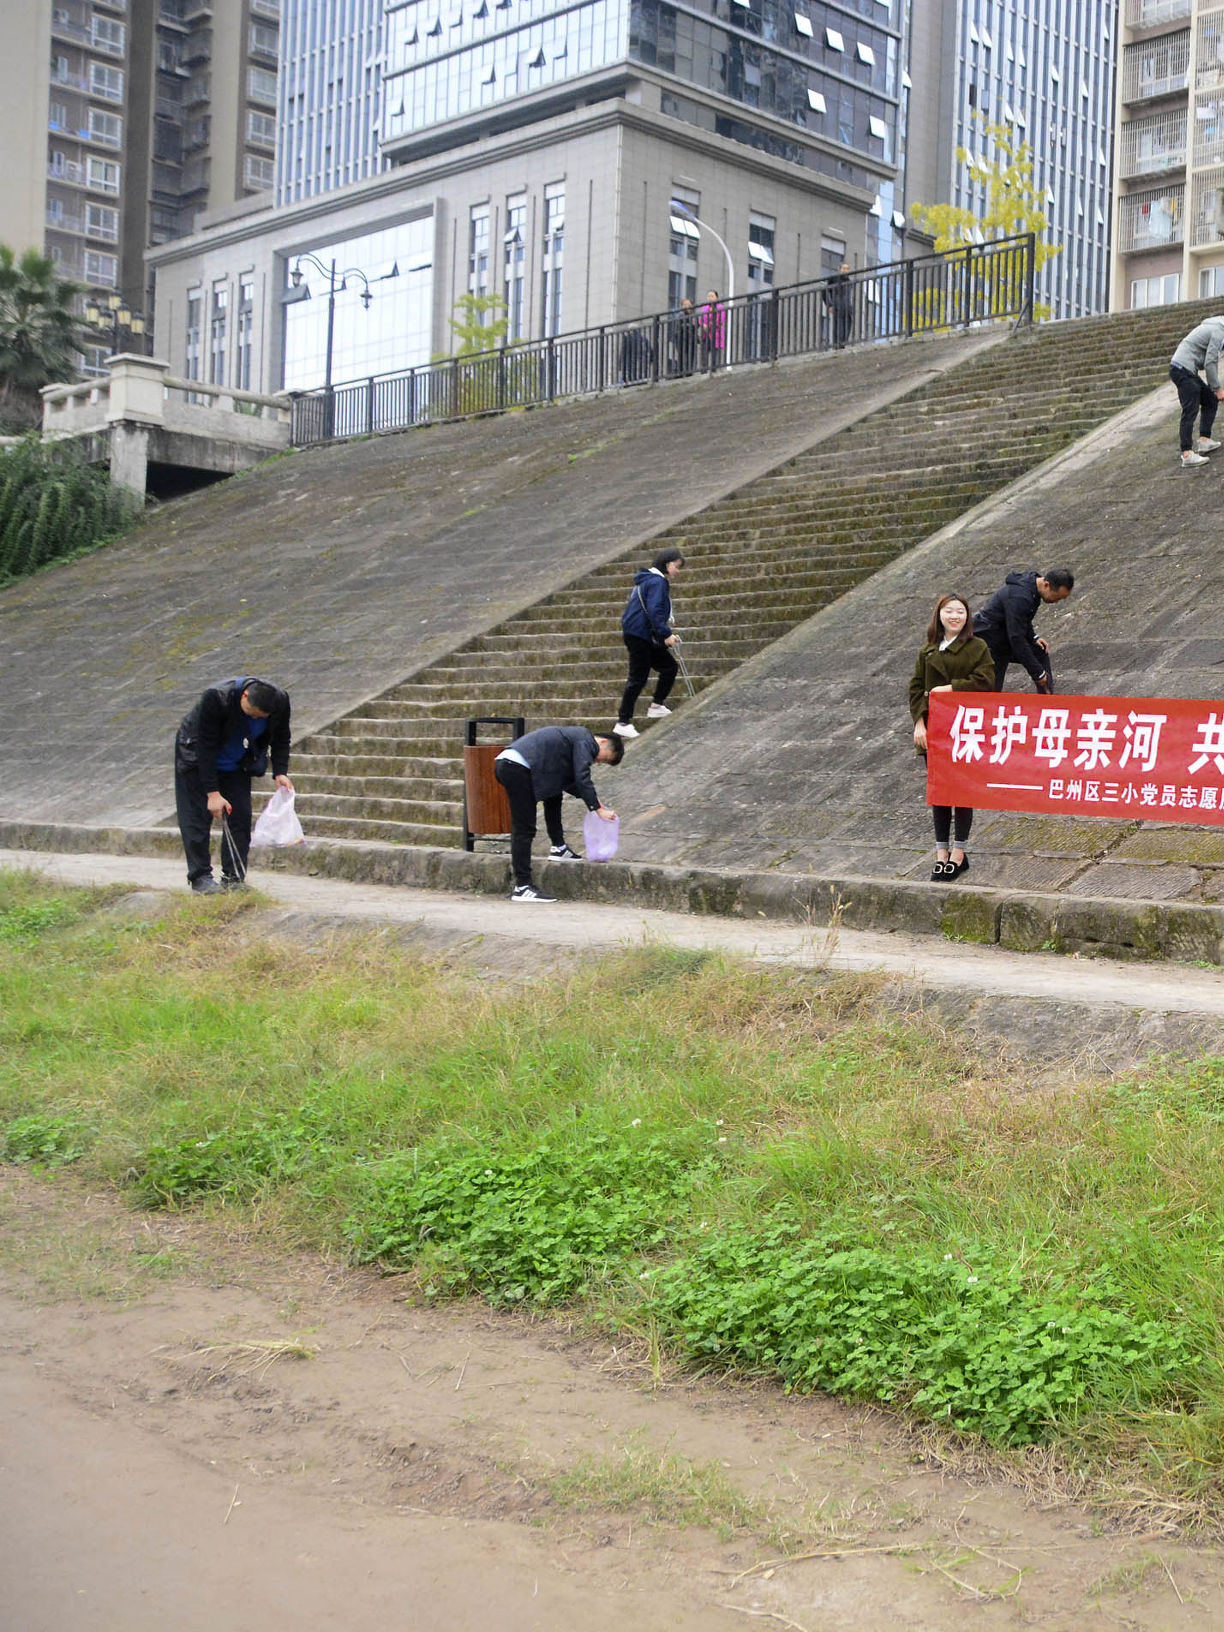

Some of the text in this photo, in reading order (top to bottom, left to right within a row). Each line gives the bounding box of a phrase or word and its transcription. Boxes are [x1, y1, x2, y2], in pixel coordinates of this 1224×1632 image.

[949, 704, 1168, 773] 保护母亲河
